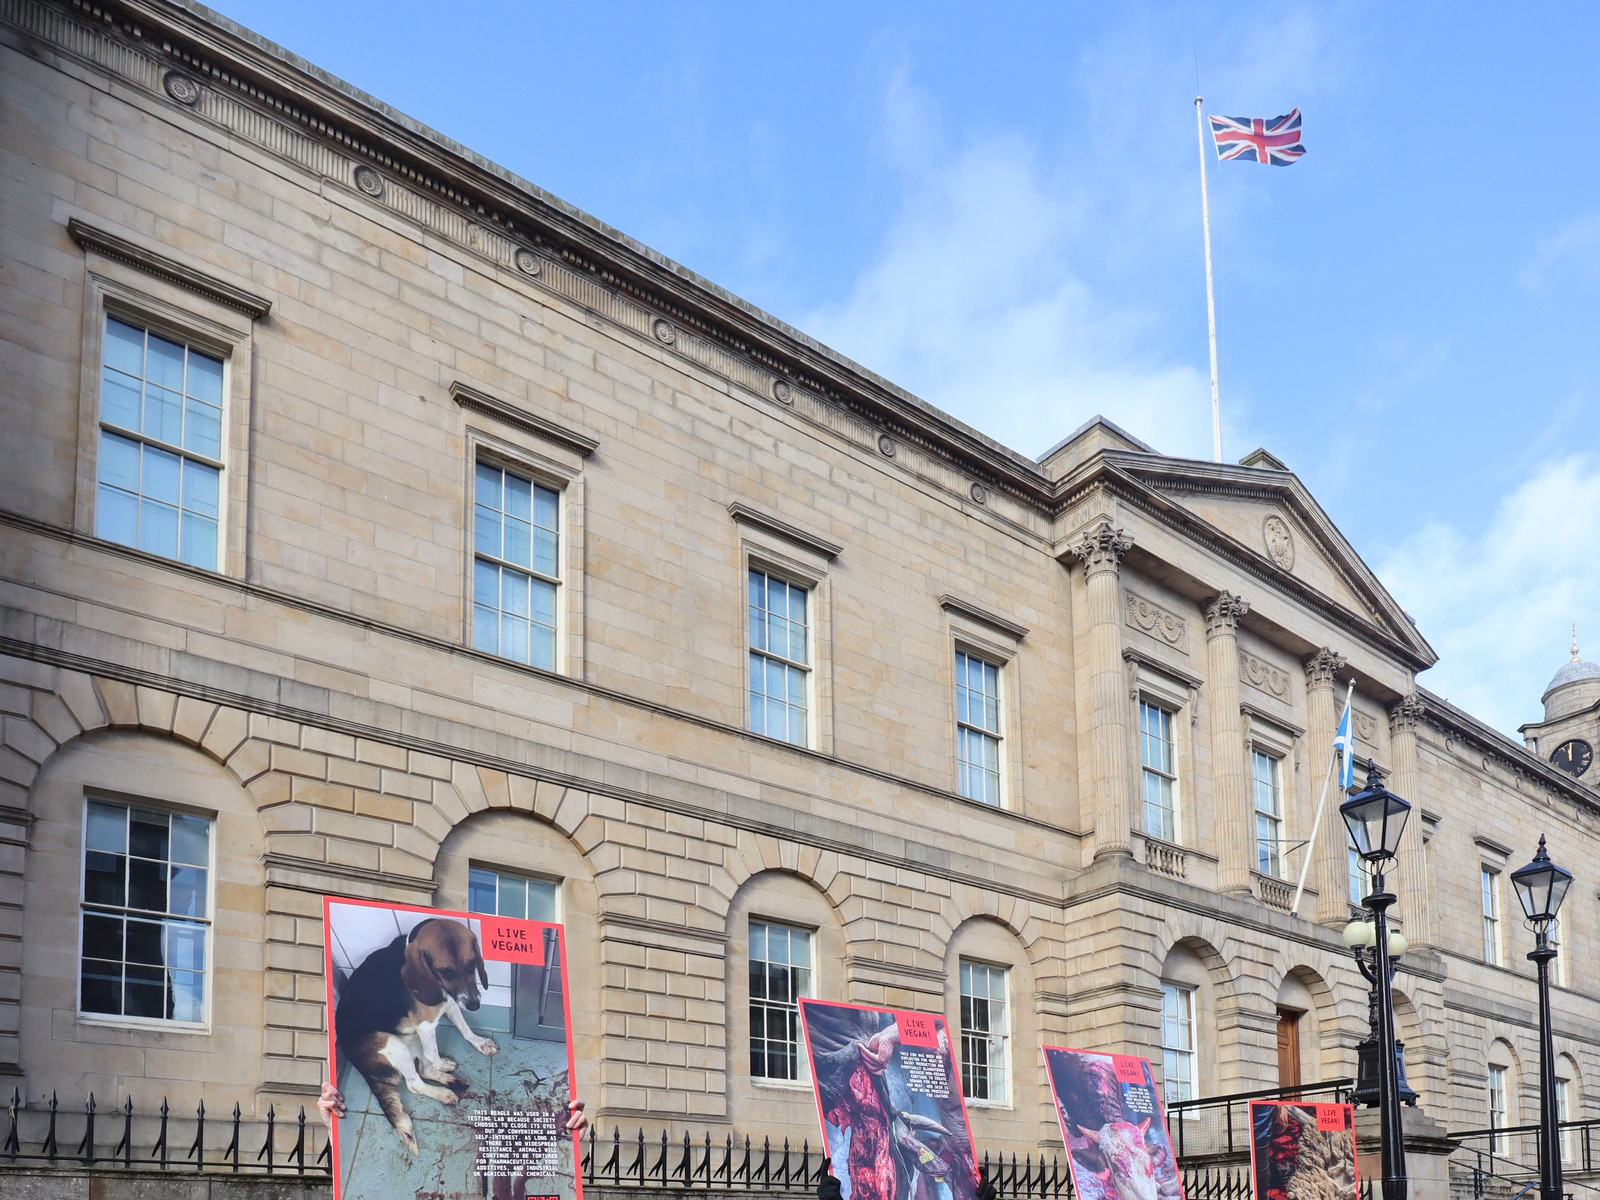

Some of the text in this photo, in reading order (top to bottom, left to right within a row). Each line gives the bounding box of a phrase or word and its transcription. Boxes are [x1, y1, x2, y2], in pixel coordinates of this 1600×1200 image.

[498, 928, 526, 940] LIVE
[492, 940, 533, 953] VEGAN!
[906, 1020, 925, 1028] LIVE
[904, 1029, 931, 1038] VEGAN!
